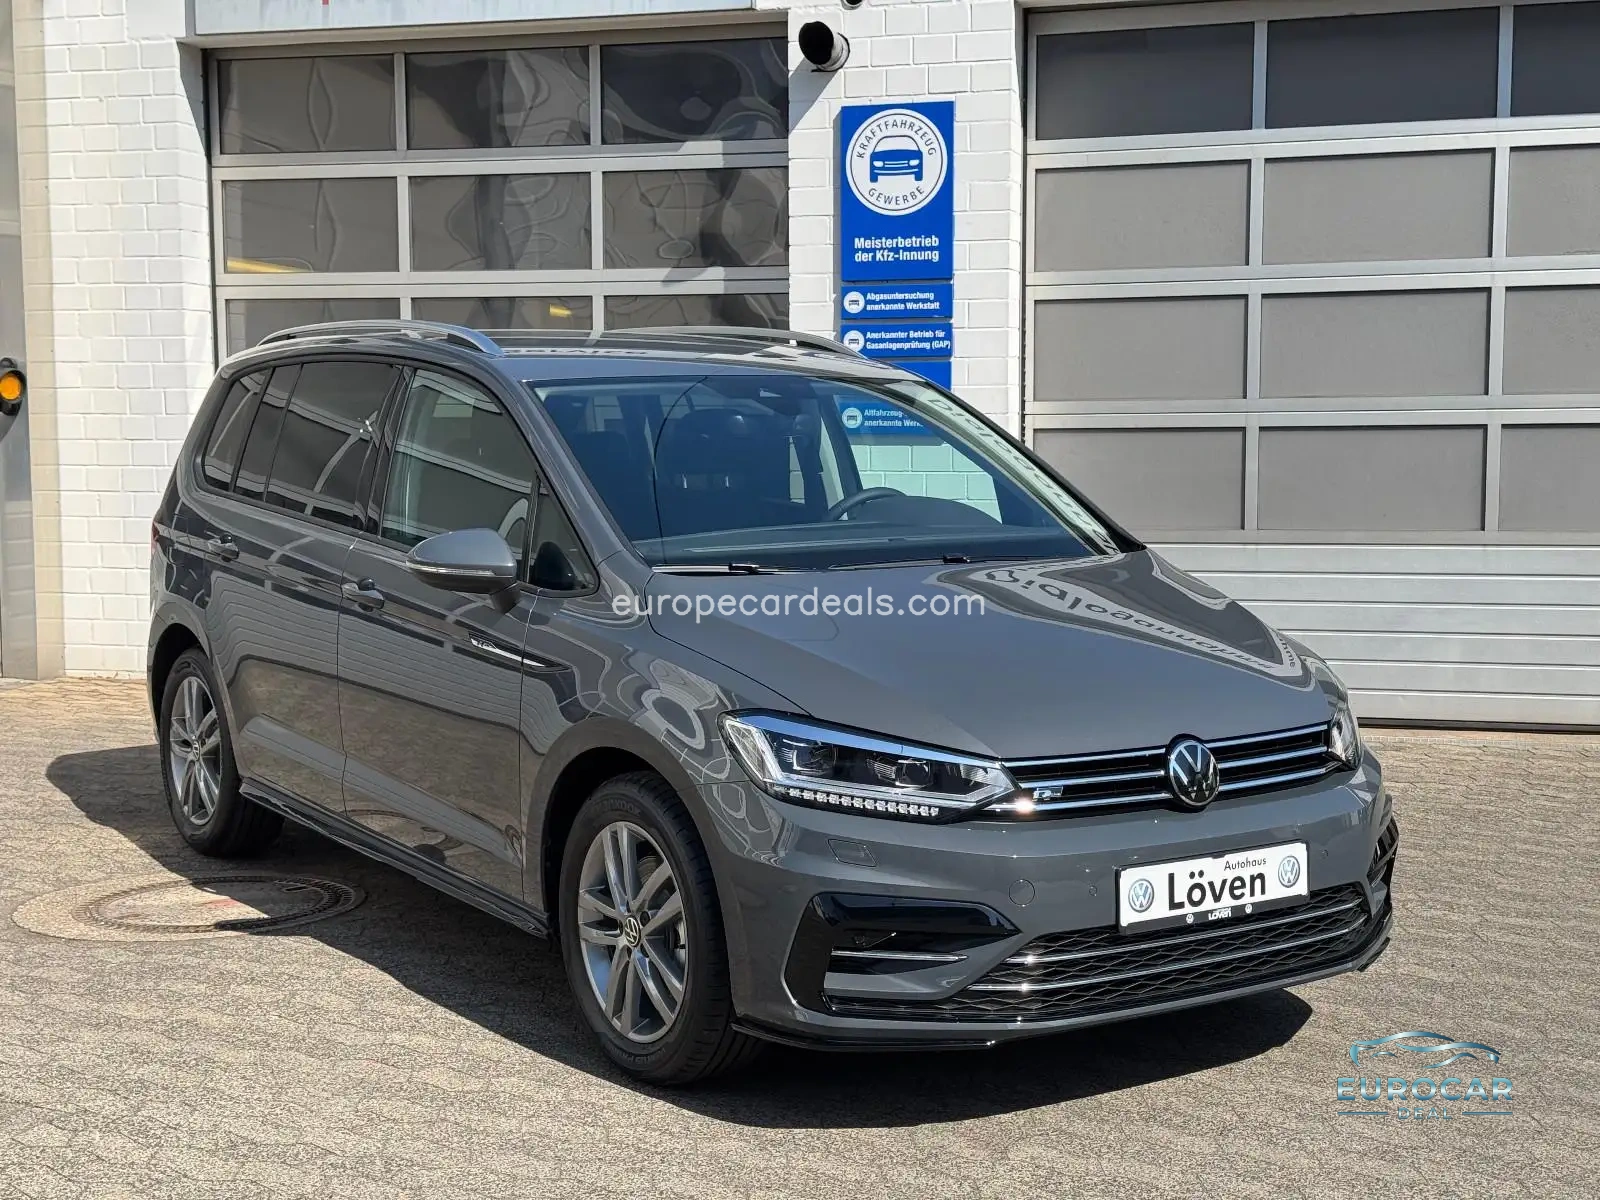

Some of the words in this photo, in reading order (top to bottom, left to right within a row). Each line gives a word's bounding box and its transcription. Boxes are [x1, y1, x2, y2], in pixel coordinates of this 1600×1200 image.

[856, 119, 937, 159] KRAFTFAHRZEUG
[868, 186, 925, 206] GEWERBE
[854, 235, 940, 249] Meisterbetrieb
[854, 250, 874, 263] der
[875, 249, 940, 263] Kfz-Innung
[866, 291, 935, 302] Abgasuntersuchung
[866, 303, 905, 311] anerkannte
[906, 302, 940, 311] Werkstatt
[866, 331, 908, 340] Anerkannter
[909, 330, 934, 339] Betrieb
[935, 330, 946, 338] für
[866, 341, 931, 351] Gasanlagenprüfung
[932, 339, 951, 350] (GAP)
[1223, 857, 1267, 872] Autohaus
[1168, 869, 1266, 911] Löven
